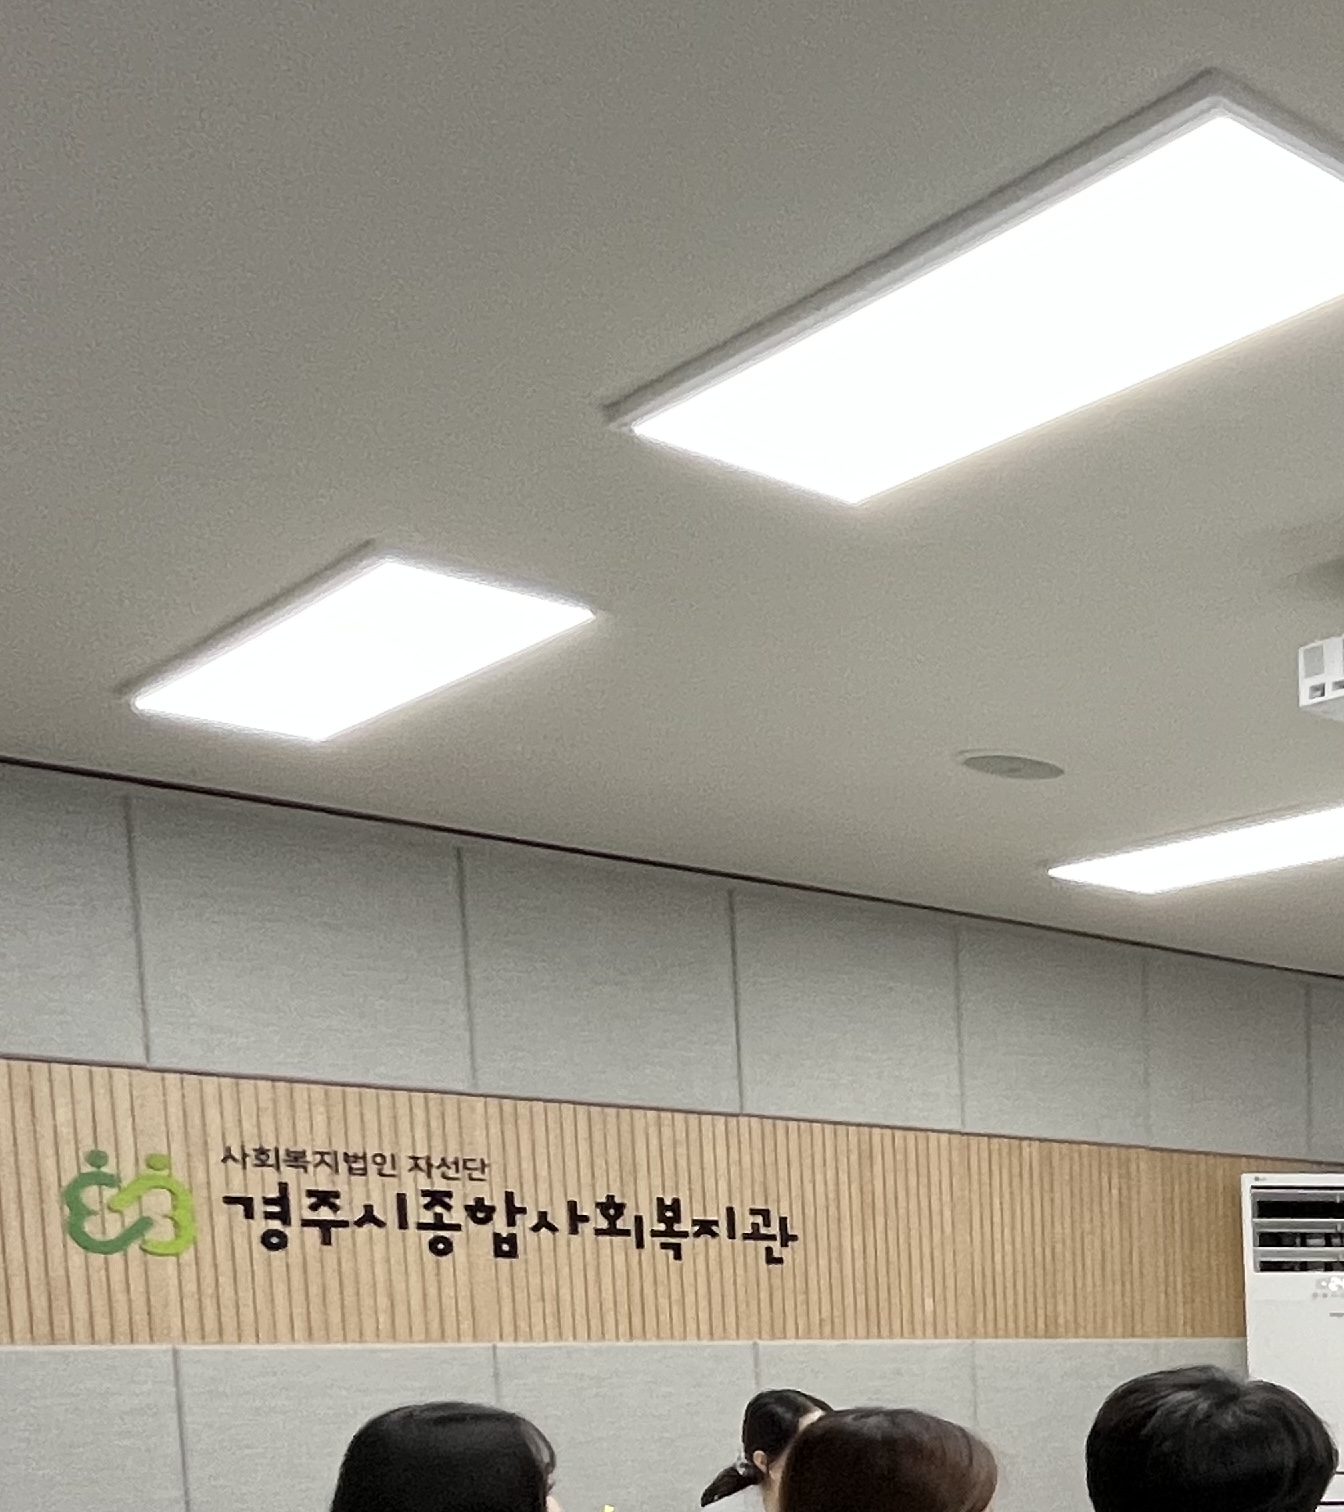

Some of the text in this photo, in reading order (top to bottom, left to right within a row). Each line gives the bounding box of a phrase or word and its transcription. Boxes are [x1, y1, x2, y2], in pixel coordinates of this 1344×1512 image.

[220, 1145, 490, 1182] 사회복지법인 자선단
[221, 1180, 799, 1266] 경주시종합사회복지관
